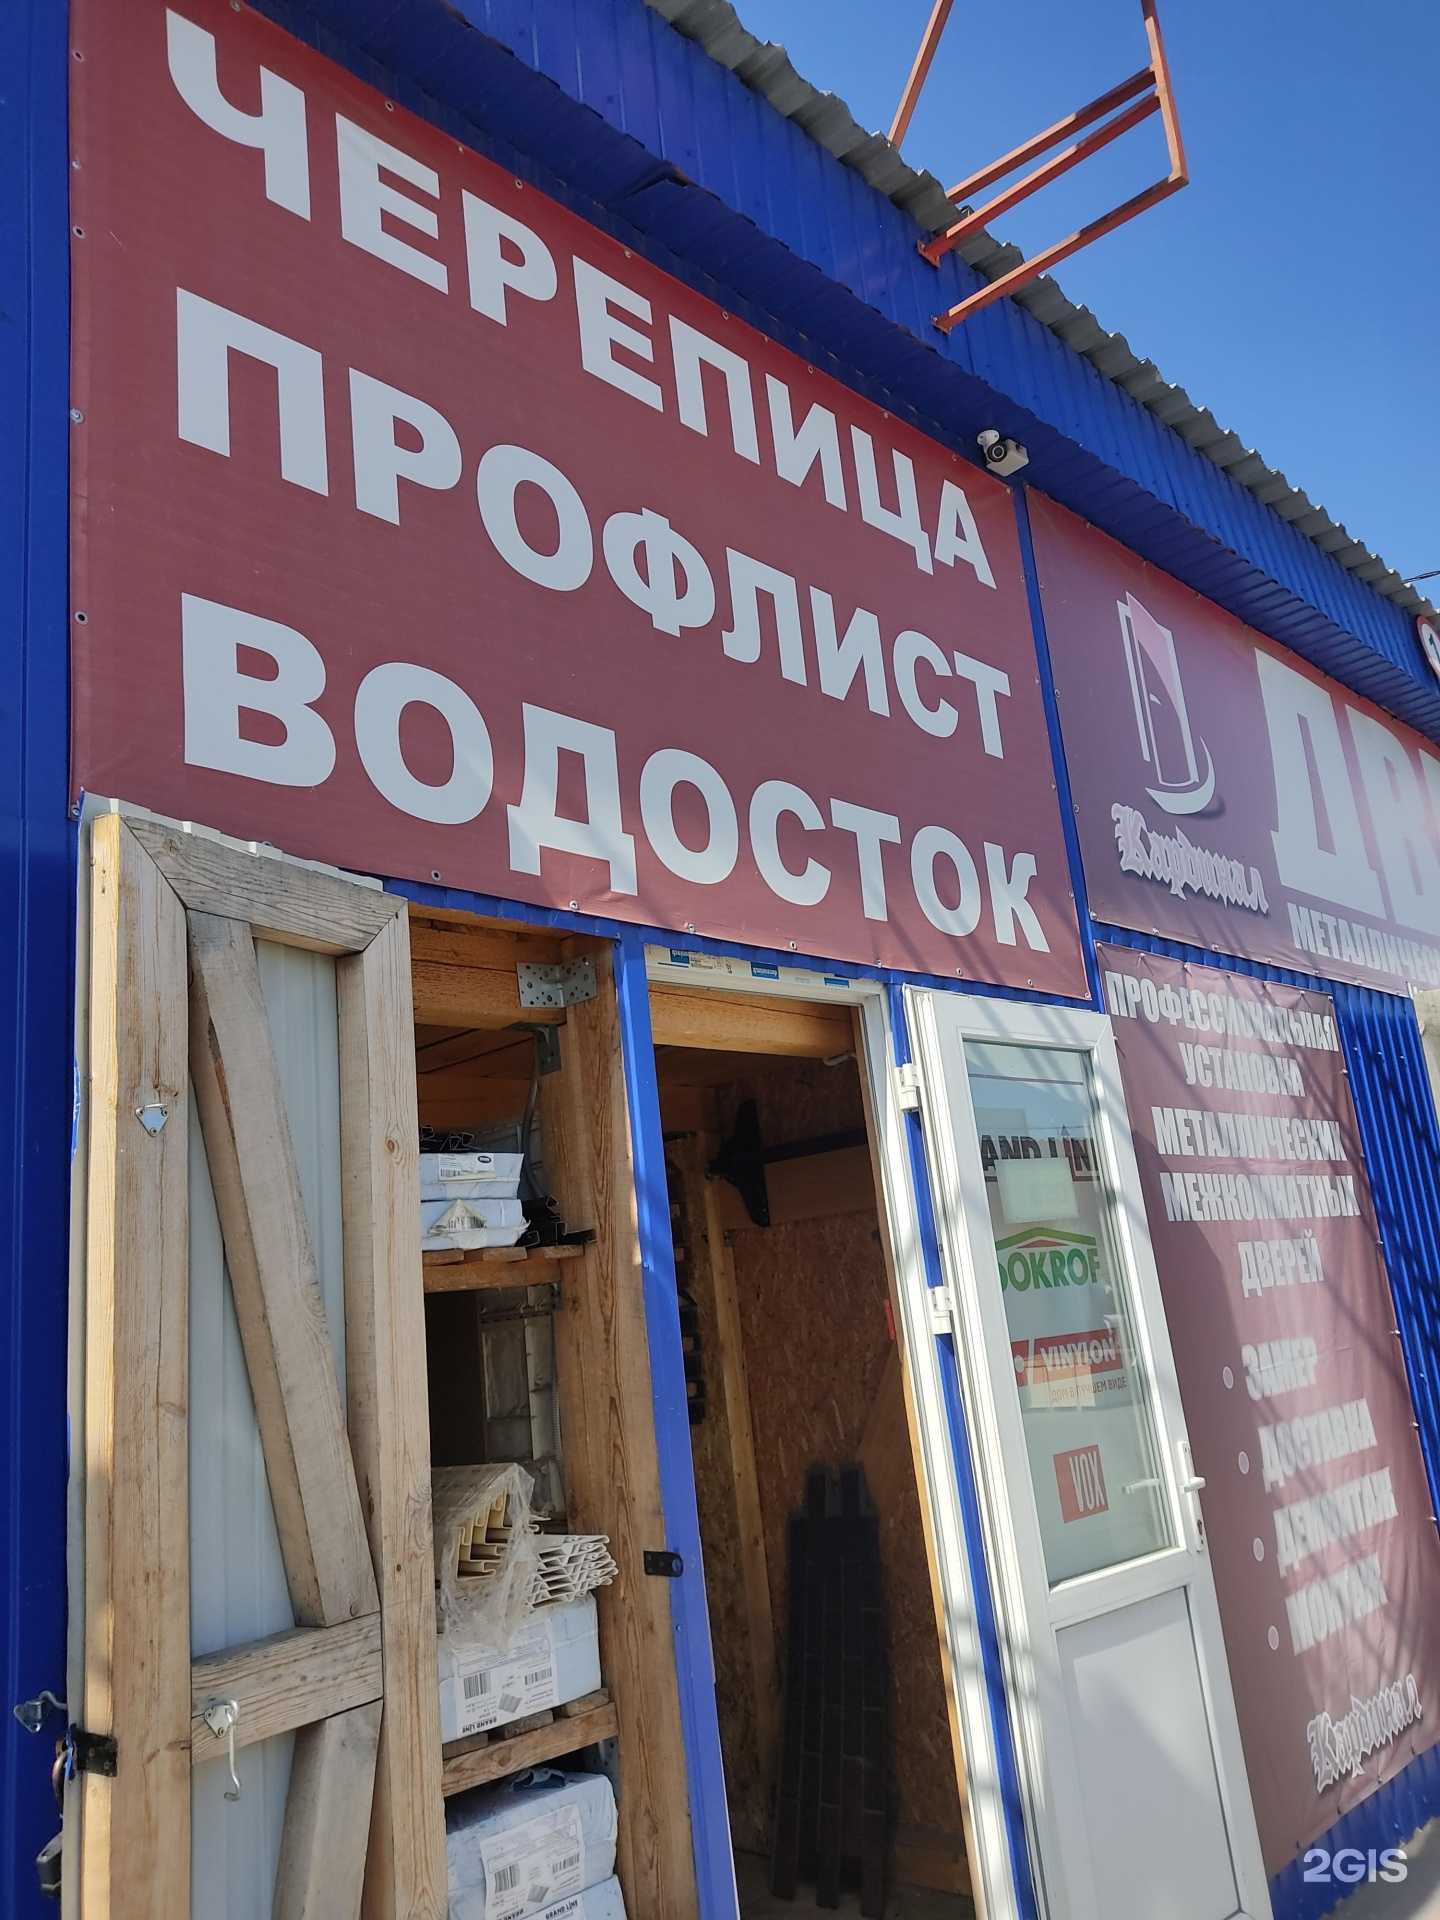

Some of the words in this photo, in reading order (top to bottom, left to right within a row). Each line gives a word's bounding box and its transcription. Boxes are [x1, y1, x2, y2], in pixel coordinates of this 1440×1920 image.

[165, 8, 996, 590] ЧЕРЕПИЦА
[176, 287, 1010, 759] ПРОФЛИСТ
[181, 593, 1051, 953] ВОДОСТОК
[1179, 1042, 1306, 1097] УСТАНОВКА
[1152, 1106, 1348, 1161] МЕТАЛЛИЧЕСКИХ
[1160, 1173, 1361, 1222] МЕЖКОМНАТНЫХ
[1238, 1233, 1324, 1299] ДВЕРЕЙ
[1258, 1398, 1378, 1493] ДОСТАВКА
